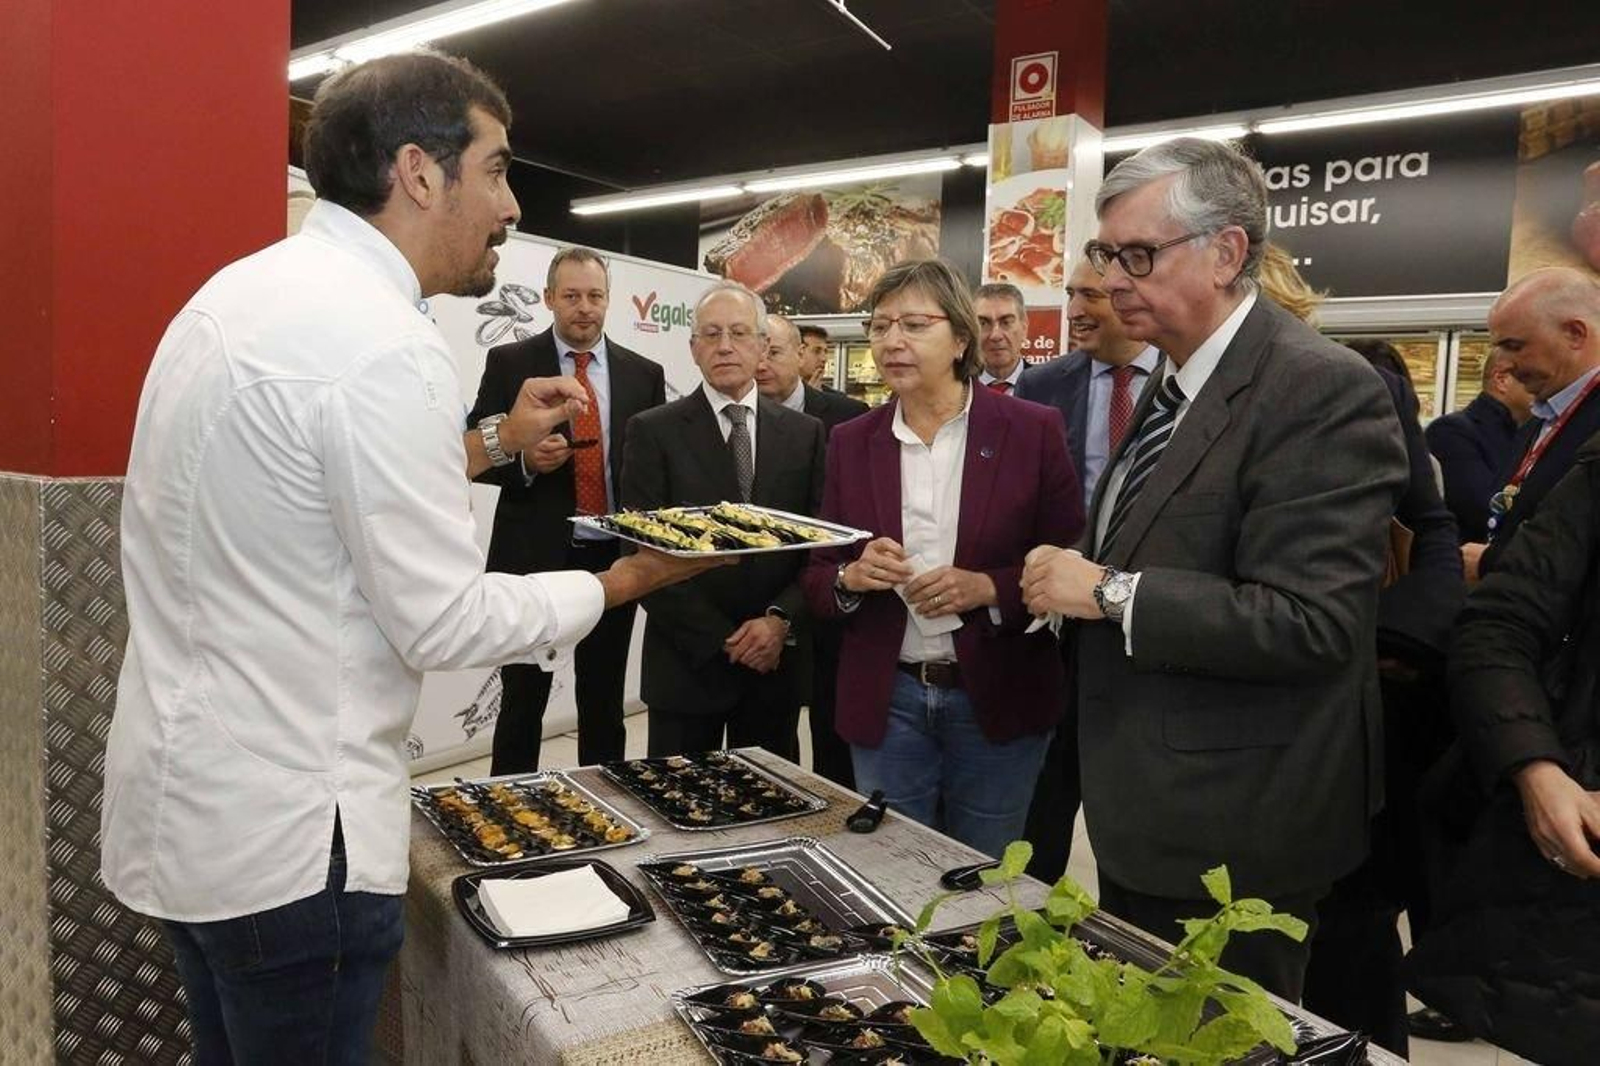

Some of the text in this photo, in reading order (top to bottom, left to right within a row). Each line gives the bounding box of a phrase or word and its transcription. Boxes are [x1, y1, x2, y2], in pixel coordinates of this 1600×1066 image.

[1013, 101, 1050, 113] PULSADOR
[1261, 151, 1429, 192] as para
[1034, 335, 1055, 349] de
